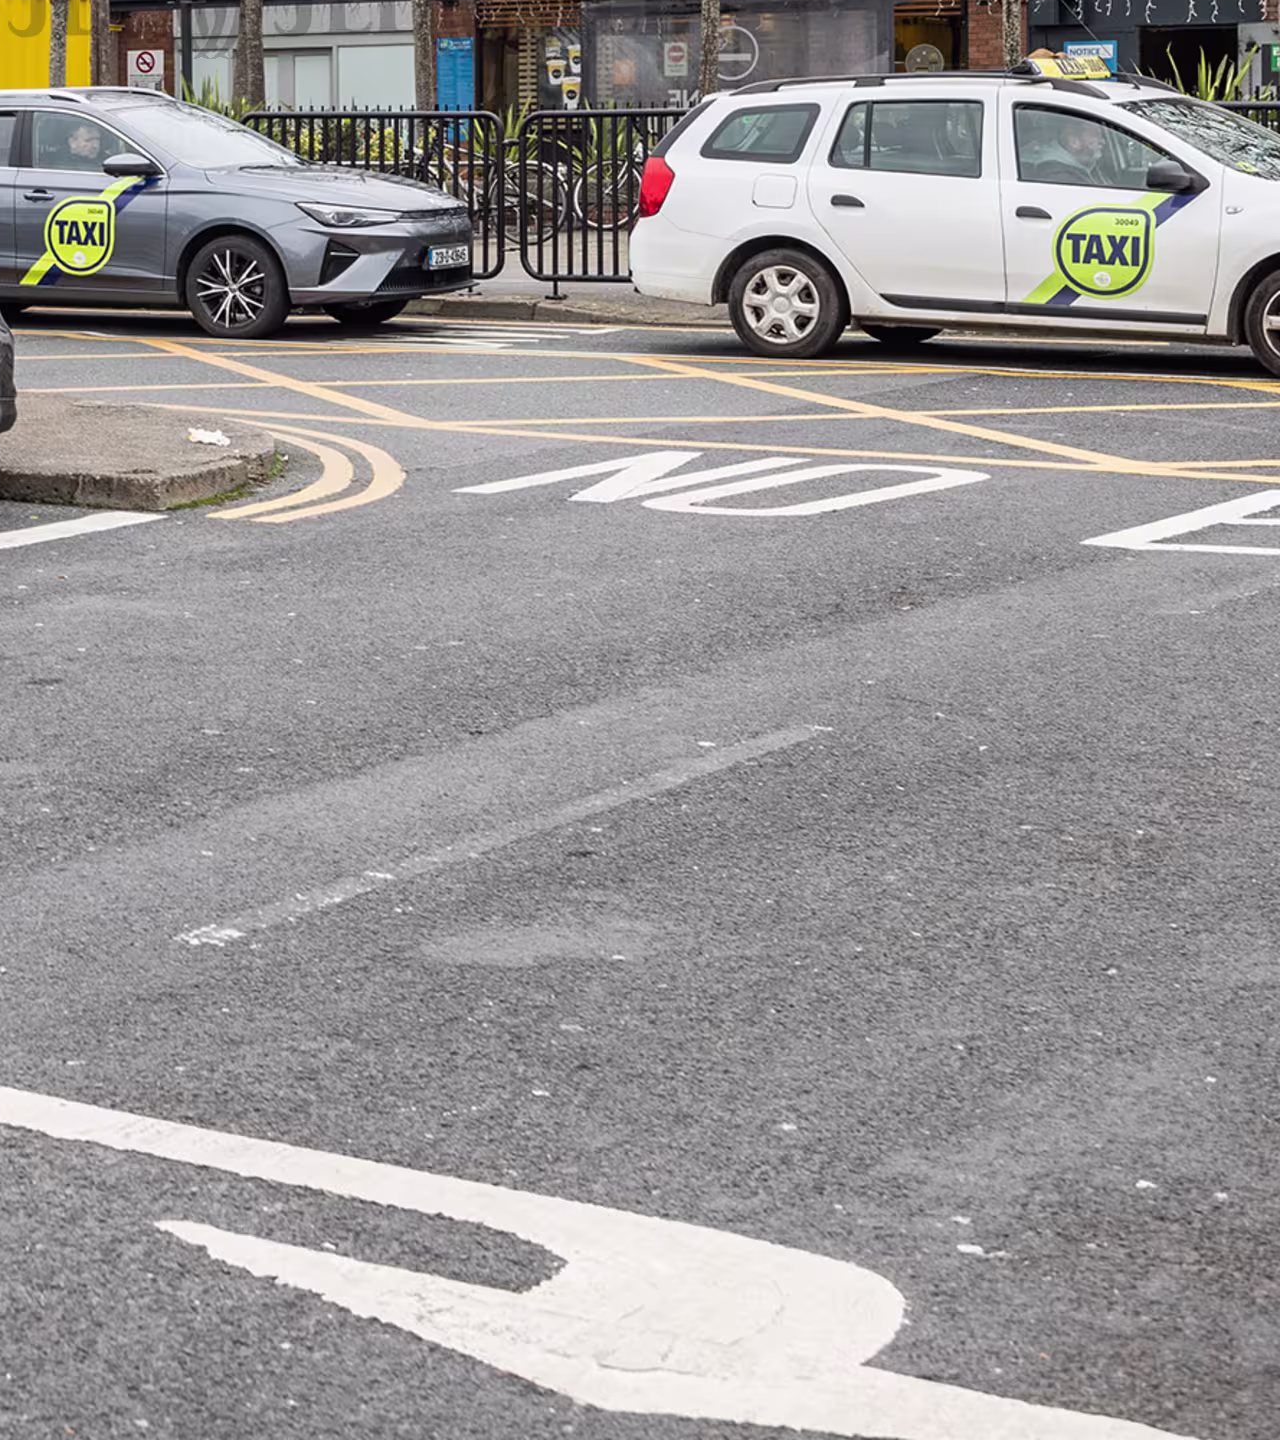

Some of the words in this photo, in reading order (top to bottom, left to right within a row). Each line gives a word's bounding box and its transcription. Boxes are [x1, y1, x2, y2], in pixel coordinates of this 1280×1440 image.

[1069, 48, 1101, 56] NOTICE
[55, 221, 105, 246] TAXI
[1066, 233, 1140, 266] TAXI
[452, 449, 992, 517] NO
